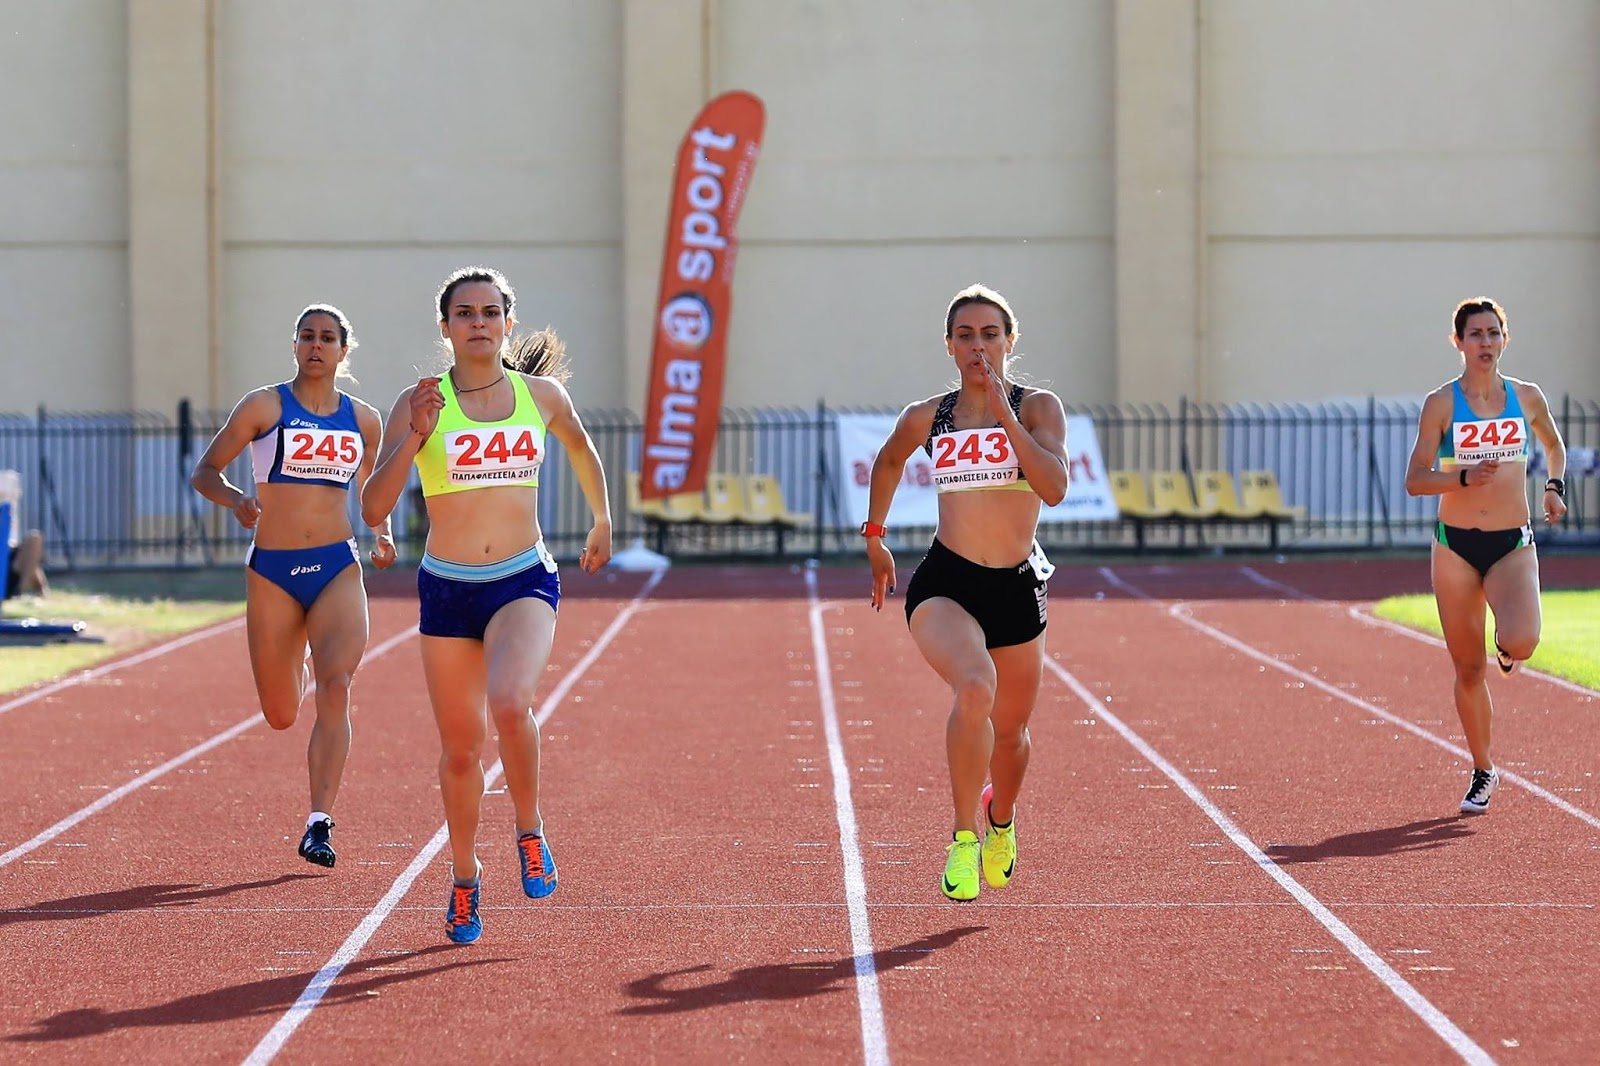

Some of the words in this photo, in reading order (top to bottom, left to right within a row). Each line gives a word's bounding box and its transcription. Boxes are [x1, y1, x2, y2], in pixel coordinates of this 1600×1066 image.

[648, 358, 702, 490] alma
[677, 127, 738, 282] sport
[299, 420, 319, 430] asics
[1460, 420, 1521, 448] 242
[291, 433, 358, 464] 245
[454, 430, 538, 466] 244
[935, 432, 1009, 469] 243
[518, 467, 537, 478] 2017
[991, 471, 1013, 481] 2017
[300, 564, 322, 574] asics
